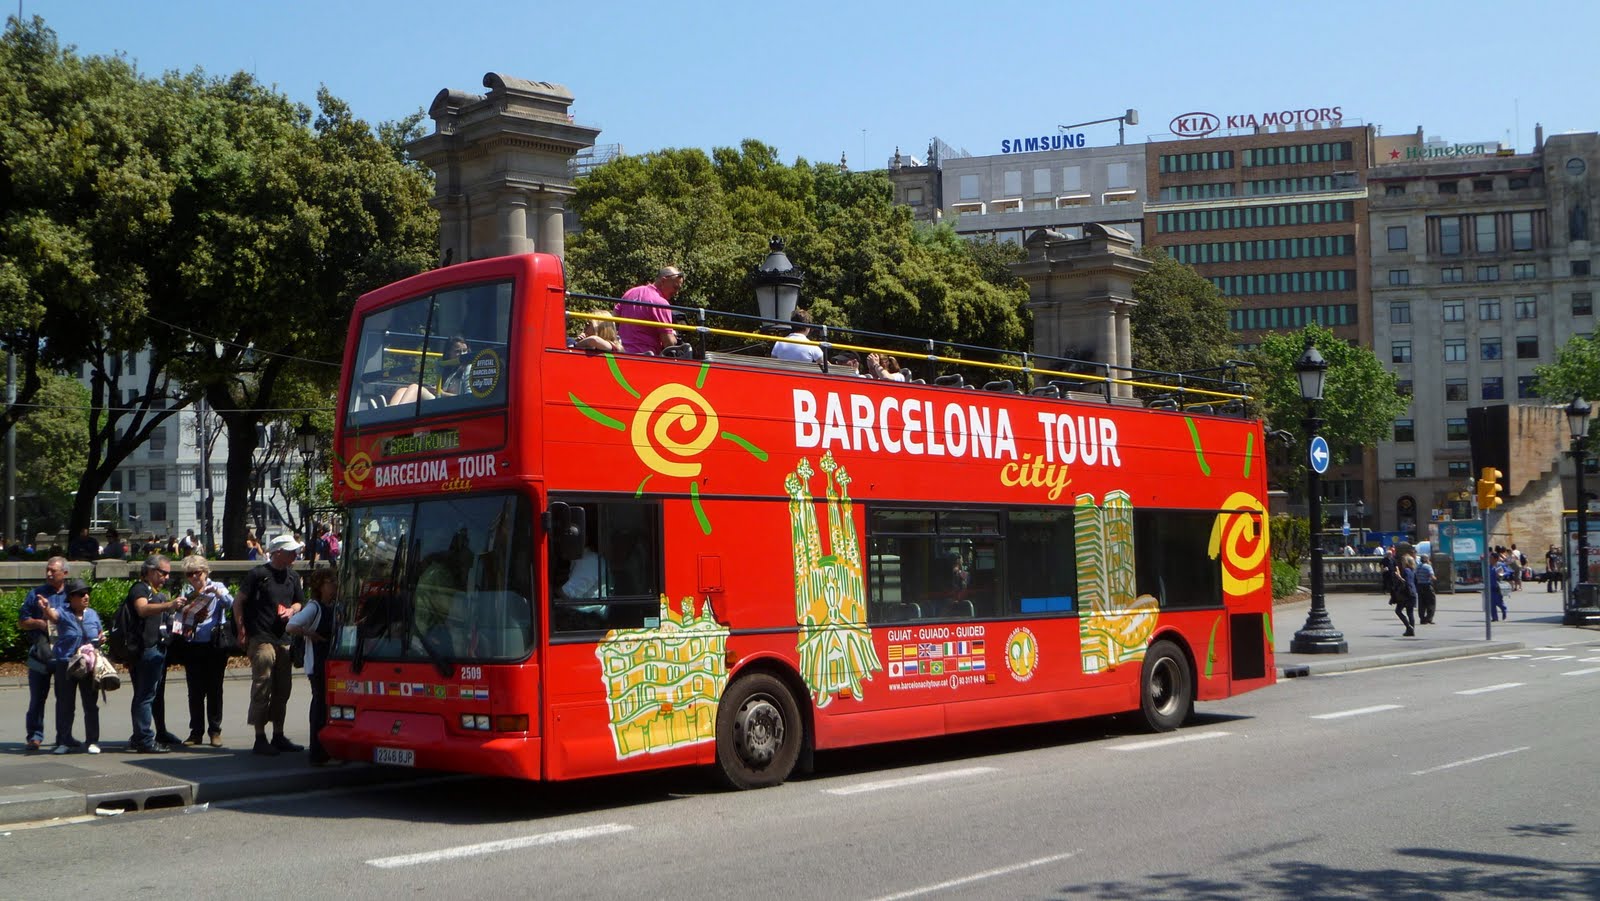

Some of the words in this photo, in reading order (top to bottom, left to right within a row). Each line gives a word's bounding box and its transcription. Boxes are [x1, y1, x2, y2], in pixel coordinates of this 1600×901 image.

[1177, 116, 1213, 132] KIA
[1227, 114, 1258, 128] KIA
[1262, 106, 1344, 126] MOTORS
[1001, 133, 1086, 153] SAMSUNG
[1406, 143, 1486, 160] Heineken
[472, 368, 497, 376] BARCELONA
[792, 388, 1019, 461] BARCELONA
[1037, 411, 1121, 467] TOUR
[390, 436, 422, 455] GREEN
[425, 431, 460, 450] ROUTE
[375, 459, 449, 488] BARCELONA
[458, 454, 497, 479] TOUR
[1000, 452, 1071, 500] city
[441, 477, 473, 492] city
[887, 629, 912, 642] GUIAT
[919, 627, 950, 640] GUIADO
[956, 625, 985, 638] GUIDED
[461, 666, 482, 680] 2509
